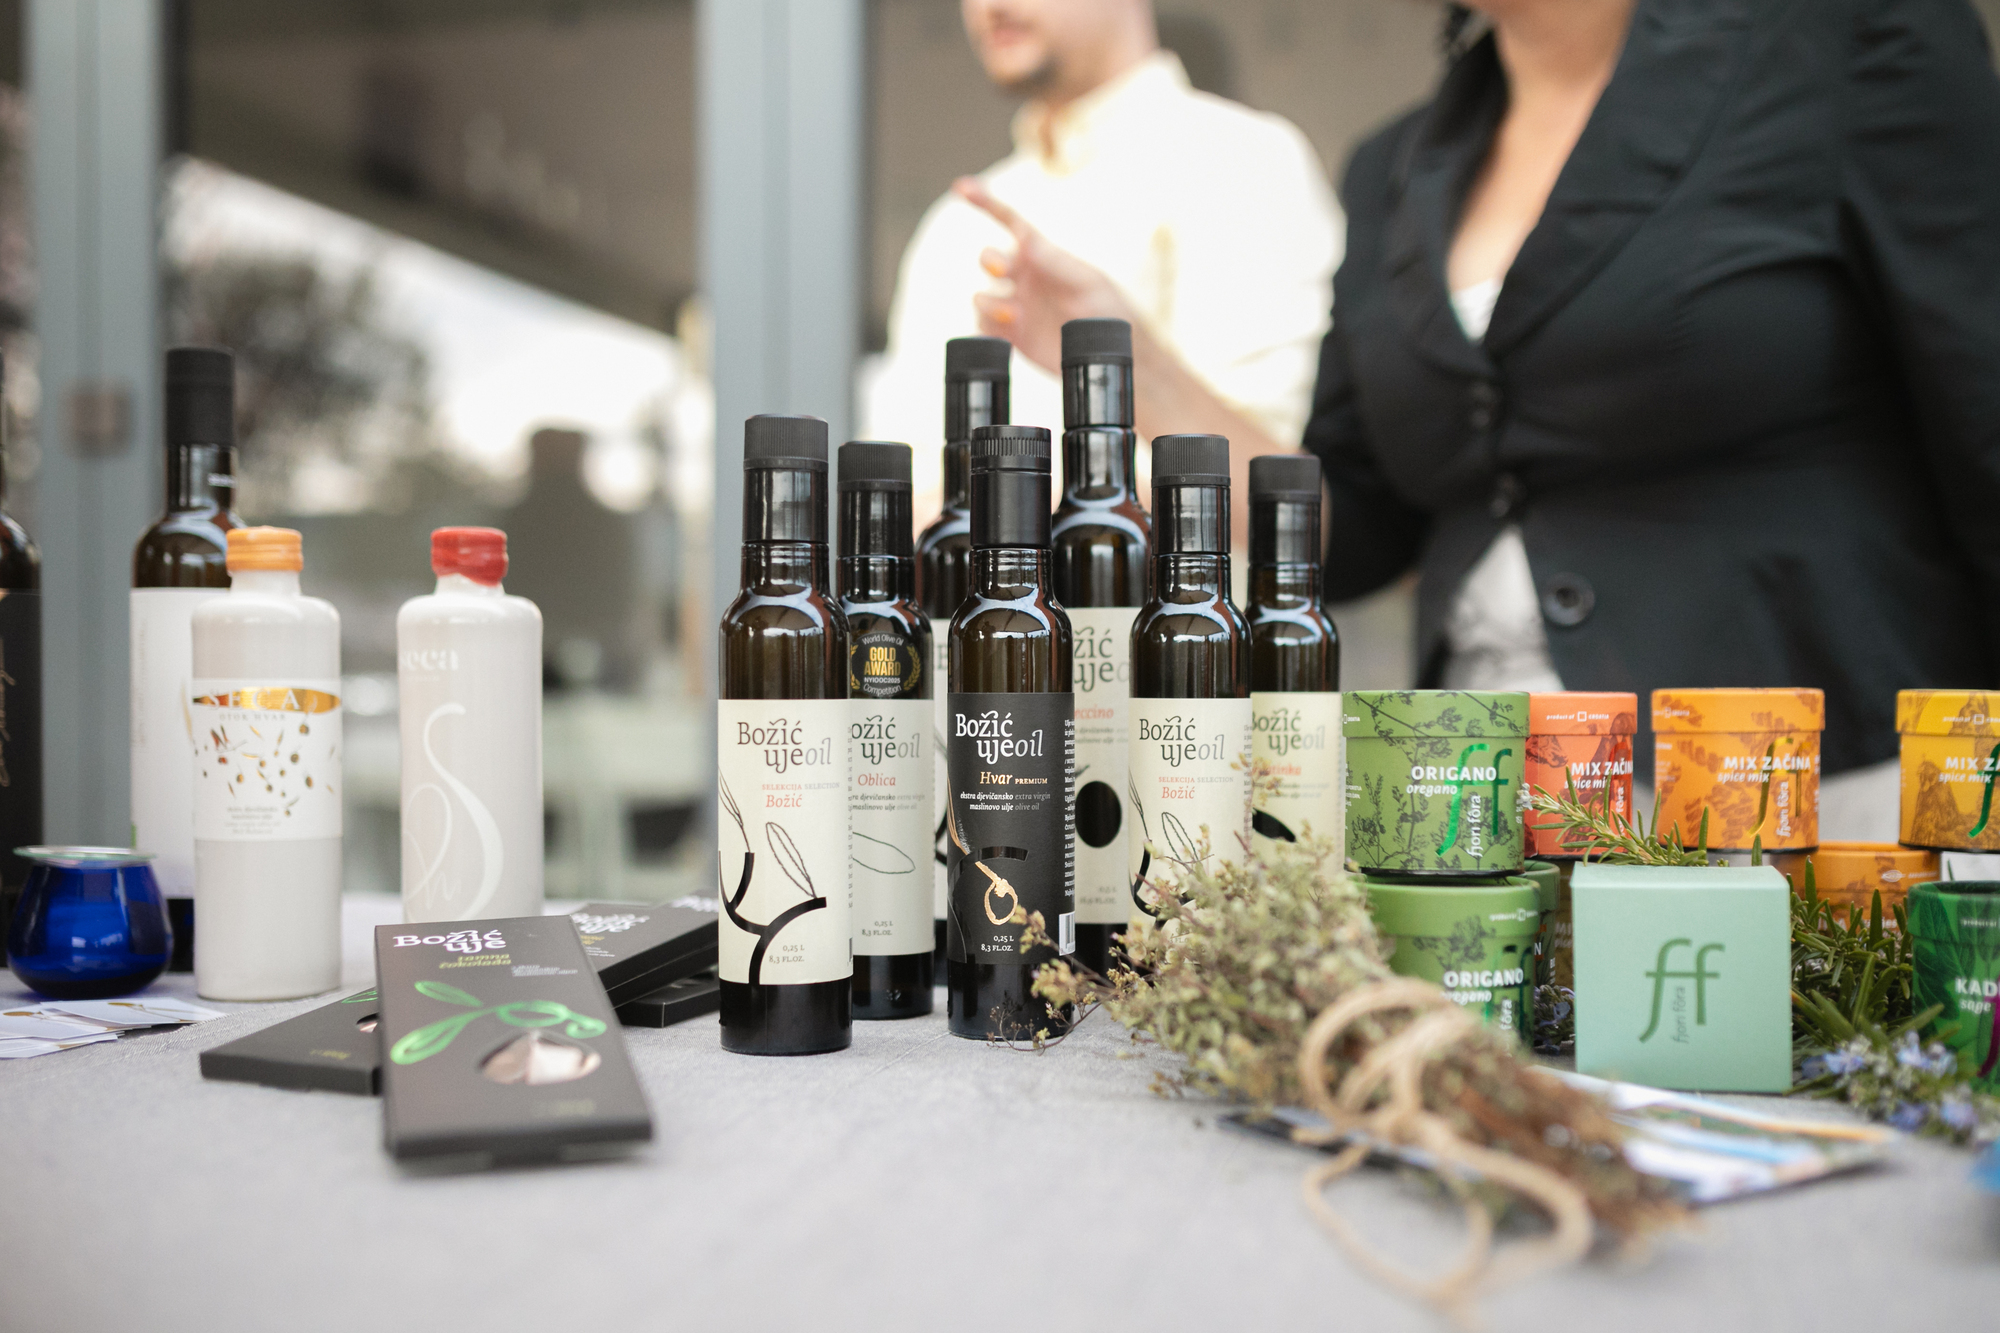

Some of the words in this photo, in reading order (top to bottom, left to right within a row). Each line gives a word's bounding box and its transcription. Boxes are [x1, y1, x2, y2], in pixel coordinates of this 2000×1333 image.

[862, 634, 880, 645] World
[881, 634, 895, 643] Olive
[1074, 627, 1113, 658] žić
[869, 647, 896, 661] GOLD
[864, 661, 901, 676] AWARD
[863, 683, 902, 697] Competition
[208, 689, 301, 710] SECA
[1074, 704, 1114, 719] eccino
[852, 715, 896, 740] ožić
[955, 710, 1014, 738] Božić
[1139, 715, 1197, 741] Božić
[737, 718, 803, 745] Božić
[1723, 756, 1757, 770] MIX
[1762, 753, 1811, 770] ZAČINA
[1946, 757, 1978, 770] MIX
[1411, 766, 1497, 781] ORIGANO
[1571, 762, 1601, 776] MIX
[857, 773, 896, 786] Oblica
[980, 771, 1013, 785] Hvar
[1717, 771, 1745, 784] spice
[1748, 771, 1770, 783] mix
[1938, 772, 1966, 783] spice
[1968, 772, 1992, 783] mix
[804, 782, 840, 790] SELECTION
[1161, 786, 1196, 799] Božić
[1406, 784, 1458, 797] oregano
[765, 792, 803, 808] Božić
[977, 792, 1014, 801] djevičansko
[1033, 792, 1051, 801] virgin
[1001, 803, 1014, 812] ulje
[393, 929, 503, 948] Božić
[443, 939, 507, 954] uje
[782, 944, 798, 952] 0,25
[981, 944, 991, 952] 8,3
[769, 955, 781, 963] 8,3
[1443, 968, 1524, 988] ORIGANO
[1960, 999, 1992, 1014] sage
